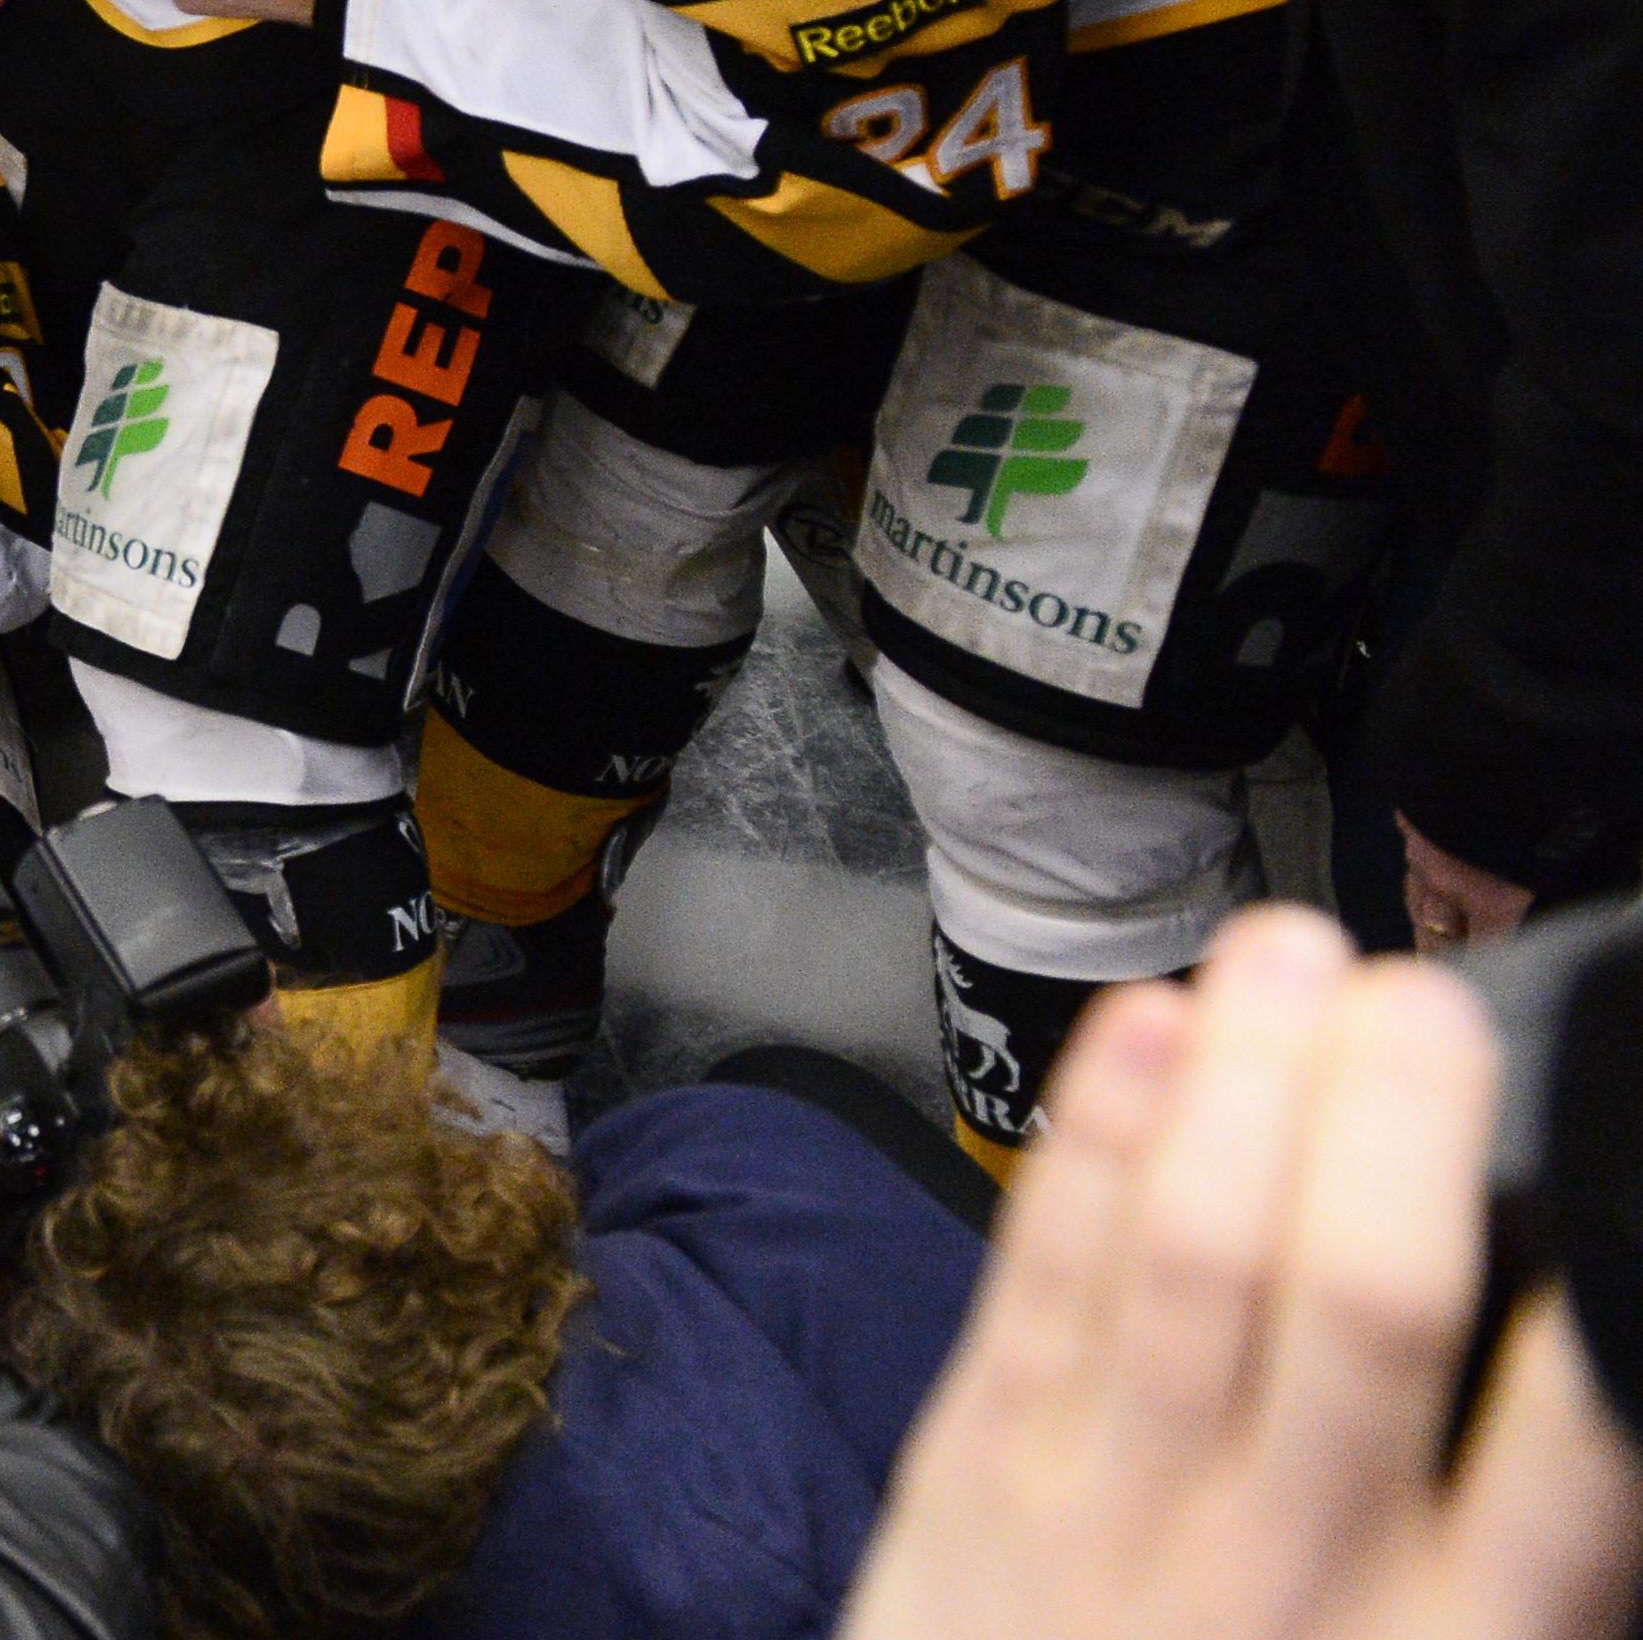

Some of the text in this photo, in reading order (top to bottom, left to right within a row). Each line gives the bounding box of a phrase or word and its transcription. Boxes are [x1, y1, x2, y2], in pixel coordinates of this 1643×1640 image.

[337, 218, 494, 498] REP
[54, 503, 199, 590] artinsons
[867, 487, 1144, 660] martinsons
